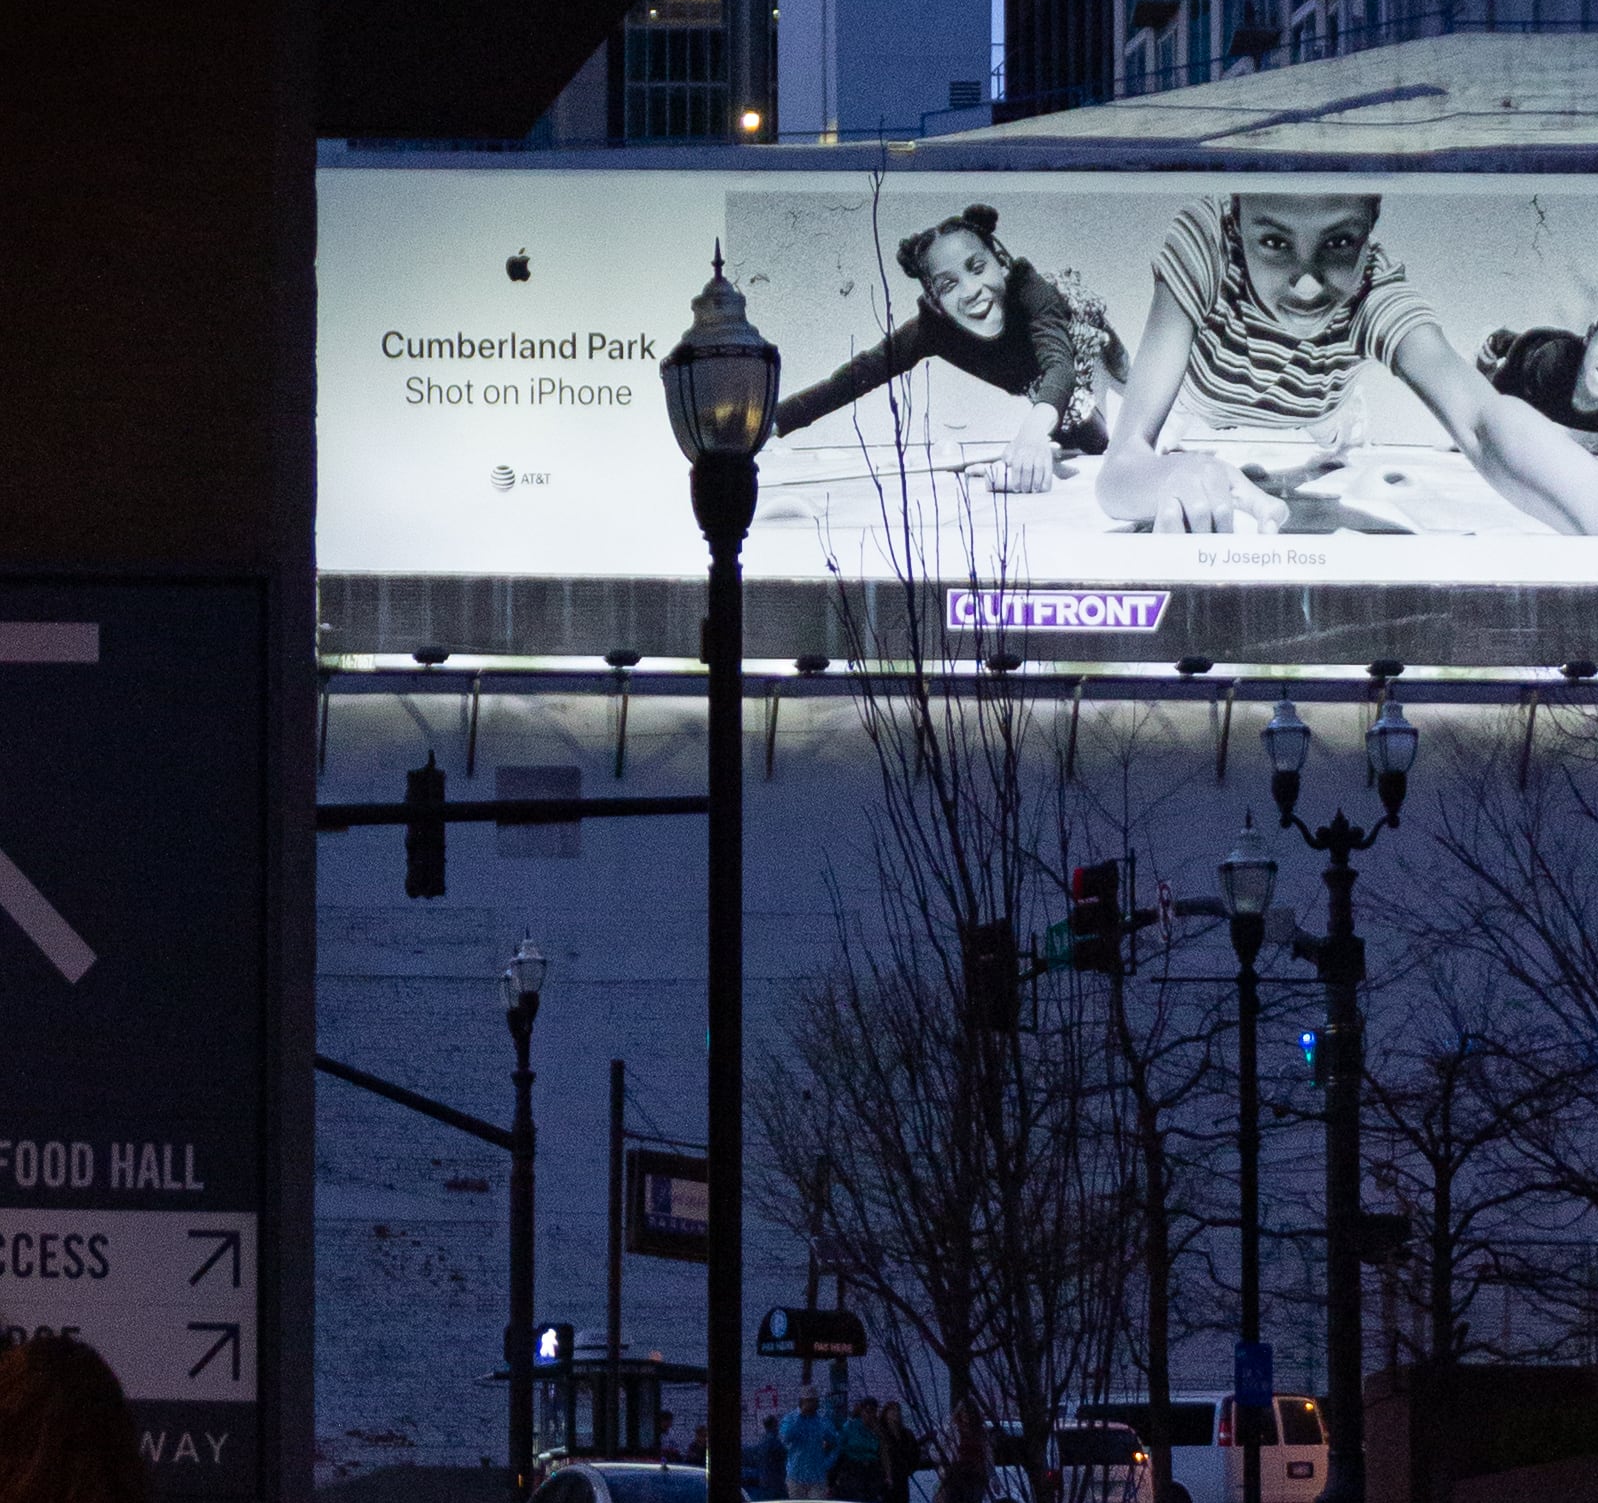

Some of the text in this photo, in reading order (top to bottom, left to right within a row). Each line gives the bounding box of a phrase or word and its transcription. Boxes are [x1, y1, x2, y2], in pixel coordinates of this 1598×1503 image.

[381, 330, 657, 361] Cumberland Park
[405, 376, 633, 407] Shot on iPhone
[520, 472, 551, 485] AT&T
[1198, 548, 1327, 567] by Joseph Ross
[955, 595, 1157, 627] OUTFRONT
[110, 1142, 205, 1191] HALL
